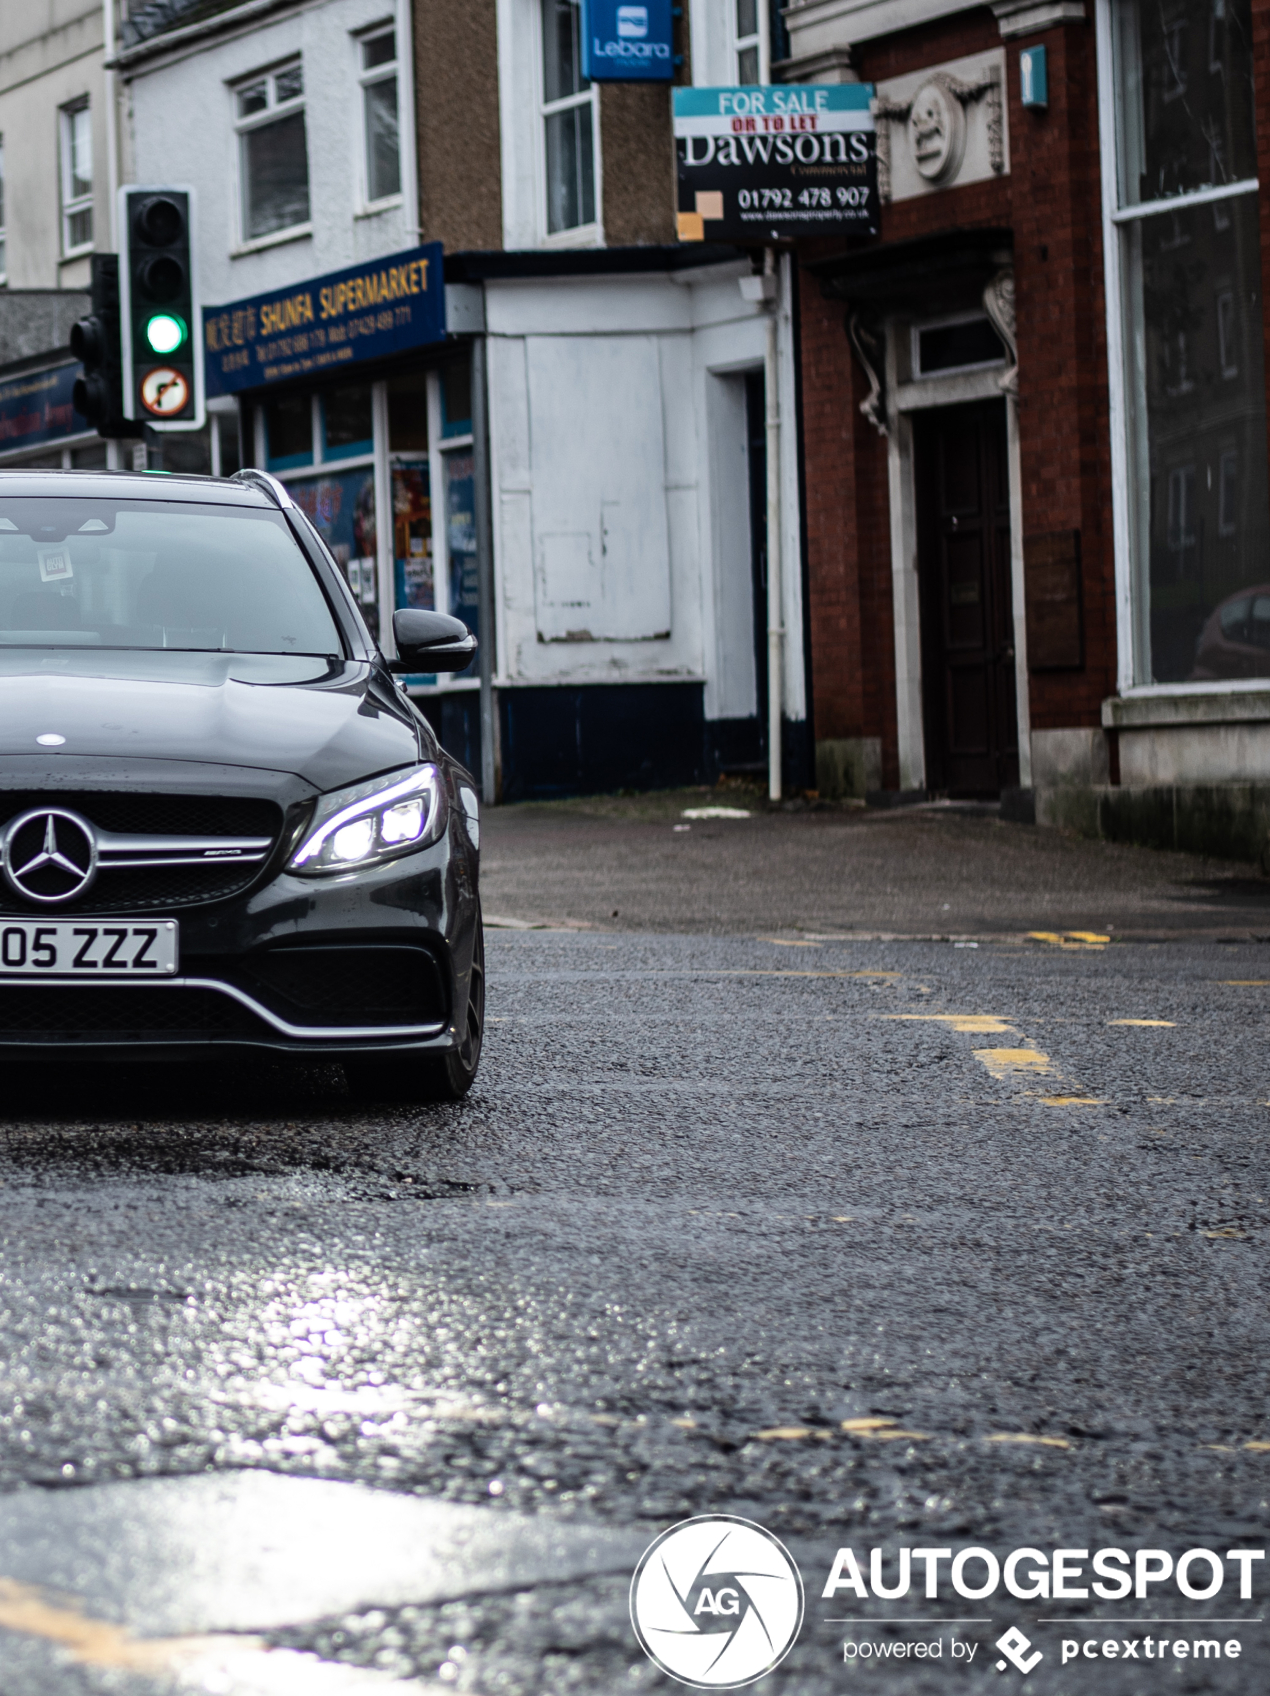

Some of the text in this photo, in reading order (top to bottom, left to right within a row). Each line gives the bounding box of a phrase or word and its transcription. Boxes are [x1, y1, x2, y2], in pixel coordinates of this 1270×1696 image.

[593, 37, 670, 58] Lebara
[718, 90, 829, 115] FOR SALE
[731, 114, 819, 133] OR TO LET
[683, 132, 869, 166] Dawsons
[738, 186, 870, 209] 01792 478 907
[260, 258, 429, 336] SHUNFA SUPERMARKET
[72, 927, 158, 969] ZZZ
